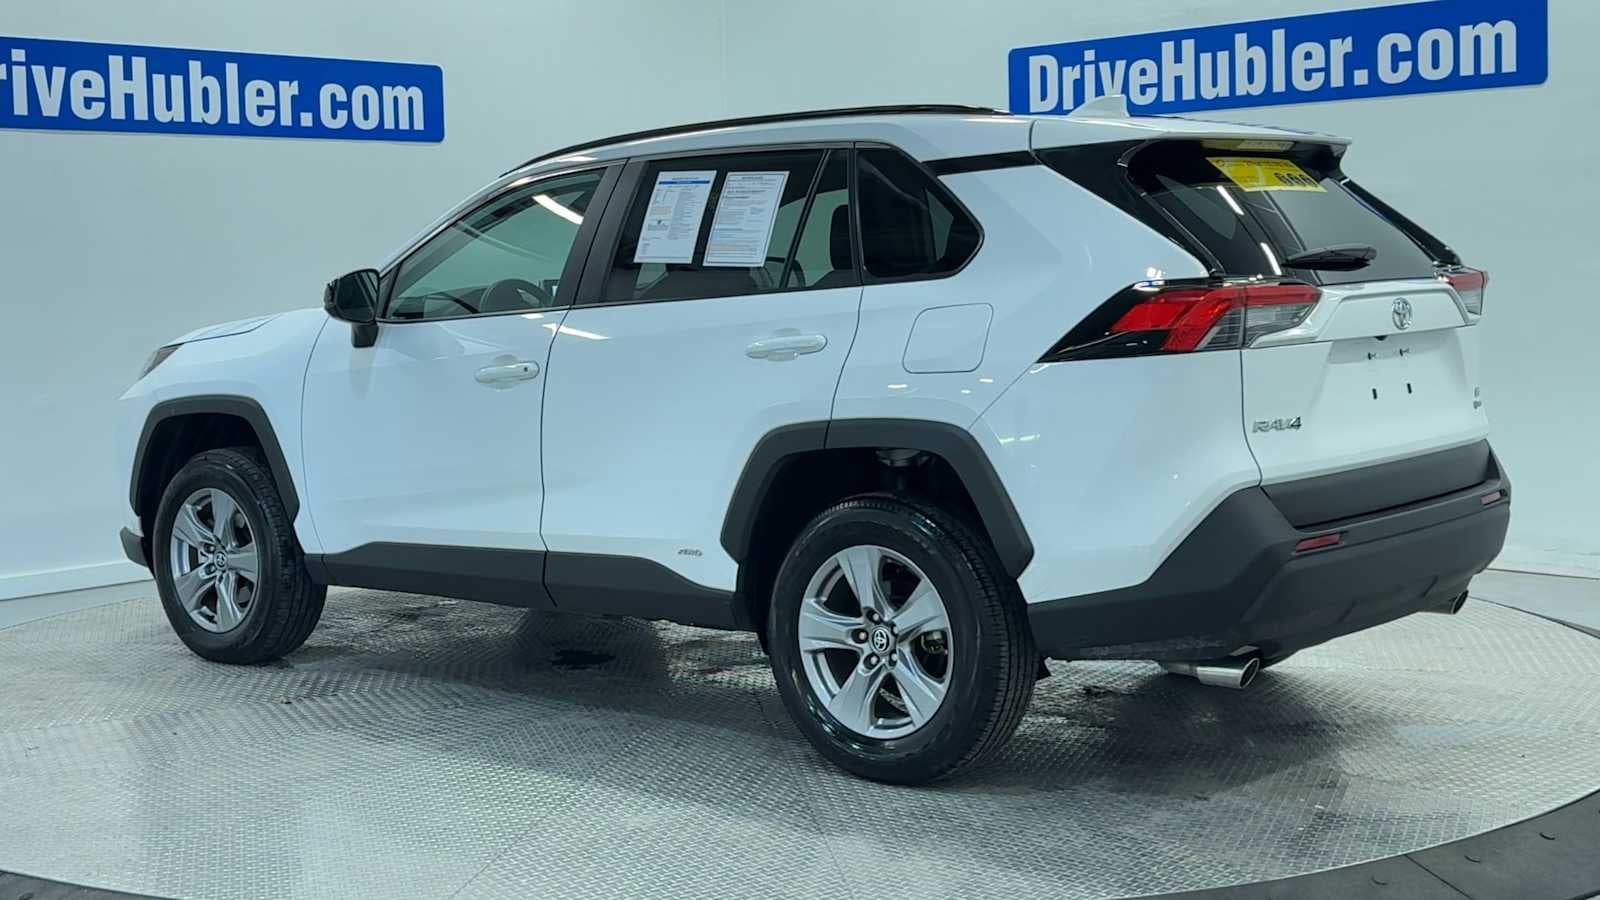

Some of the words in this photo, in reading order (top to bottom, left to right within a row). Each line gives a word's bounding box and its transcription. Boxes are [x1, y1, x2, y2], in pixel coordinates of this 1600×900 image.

[0, 48, 425, 131] iveHubler.com
[1028, 19, 1518, 113] DriveHubler.com
[1252, 416, 1302, 433] RAV4
